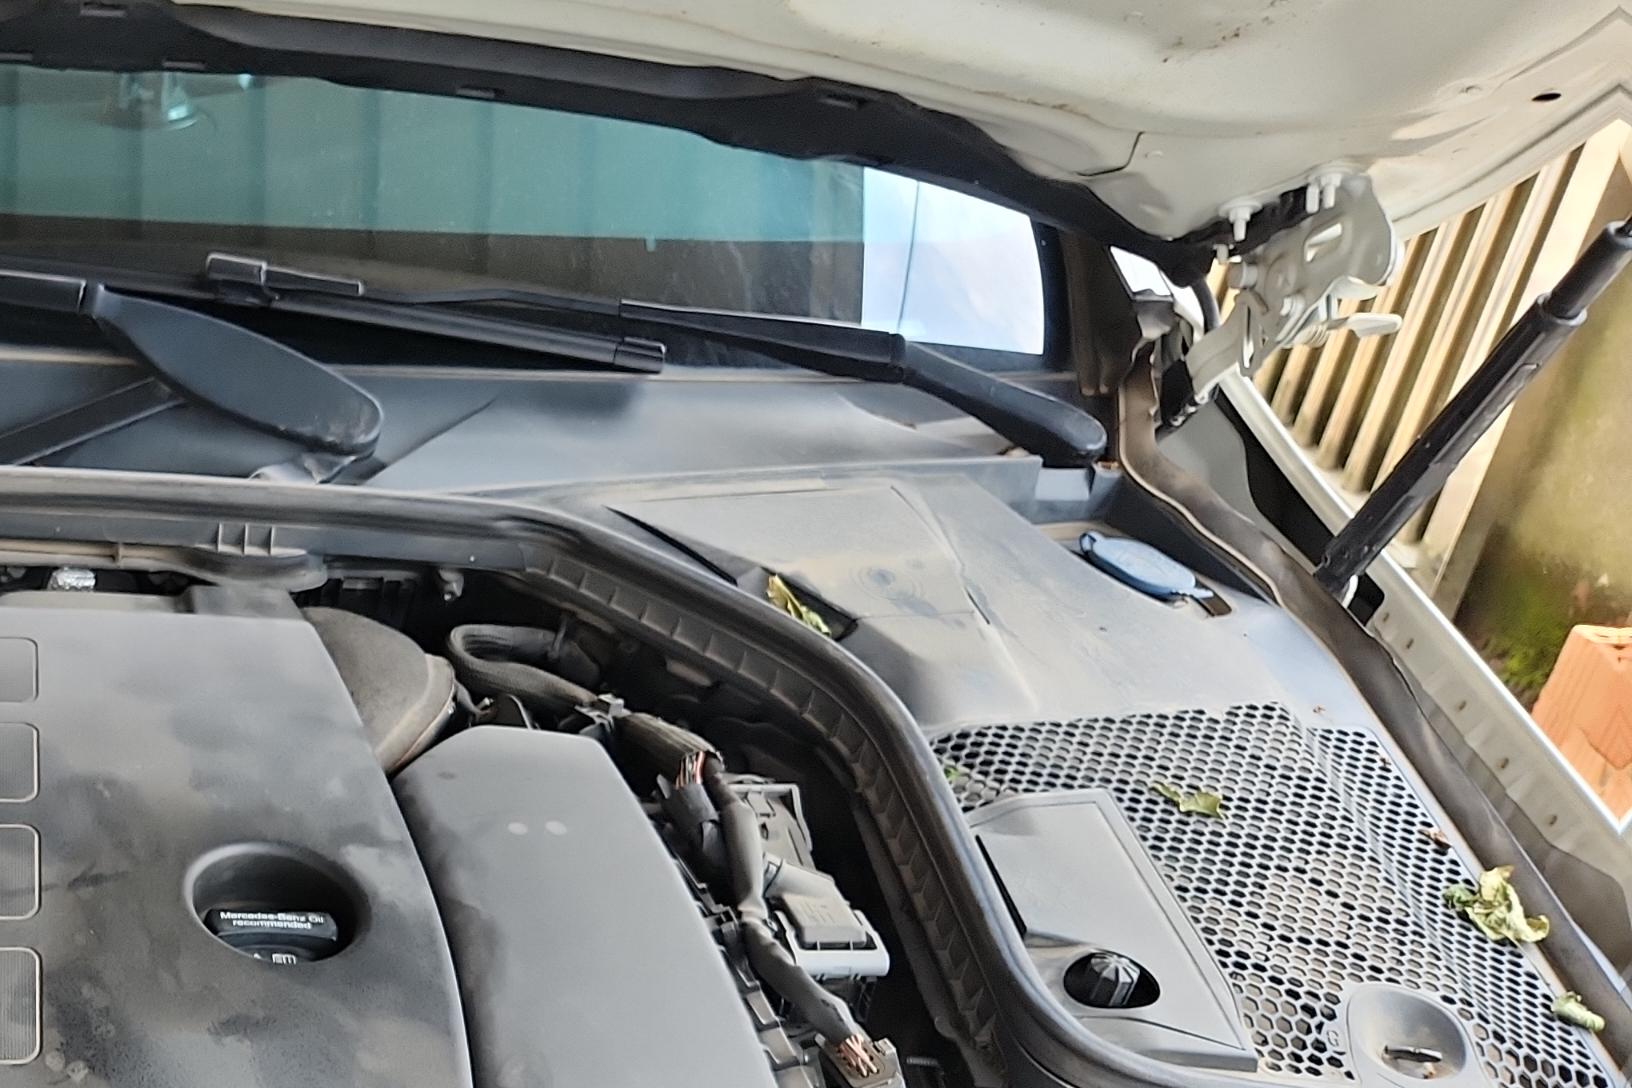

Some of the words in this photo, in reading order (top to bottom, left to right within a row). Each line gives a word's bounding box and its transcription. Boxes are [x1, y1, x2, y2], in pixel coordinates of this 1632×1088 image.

[220, 911, 306, 922] Mercedes-Benz
[308, 914, 324, 924] Oil
[232, 919, 312, 930] recommended
